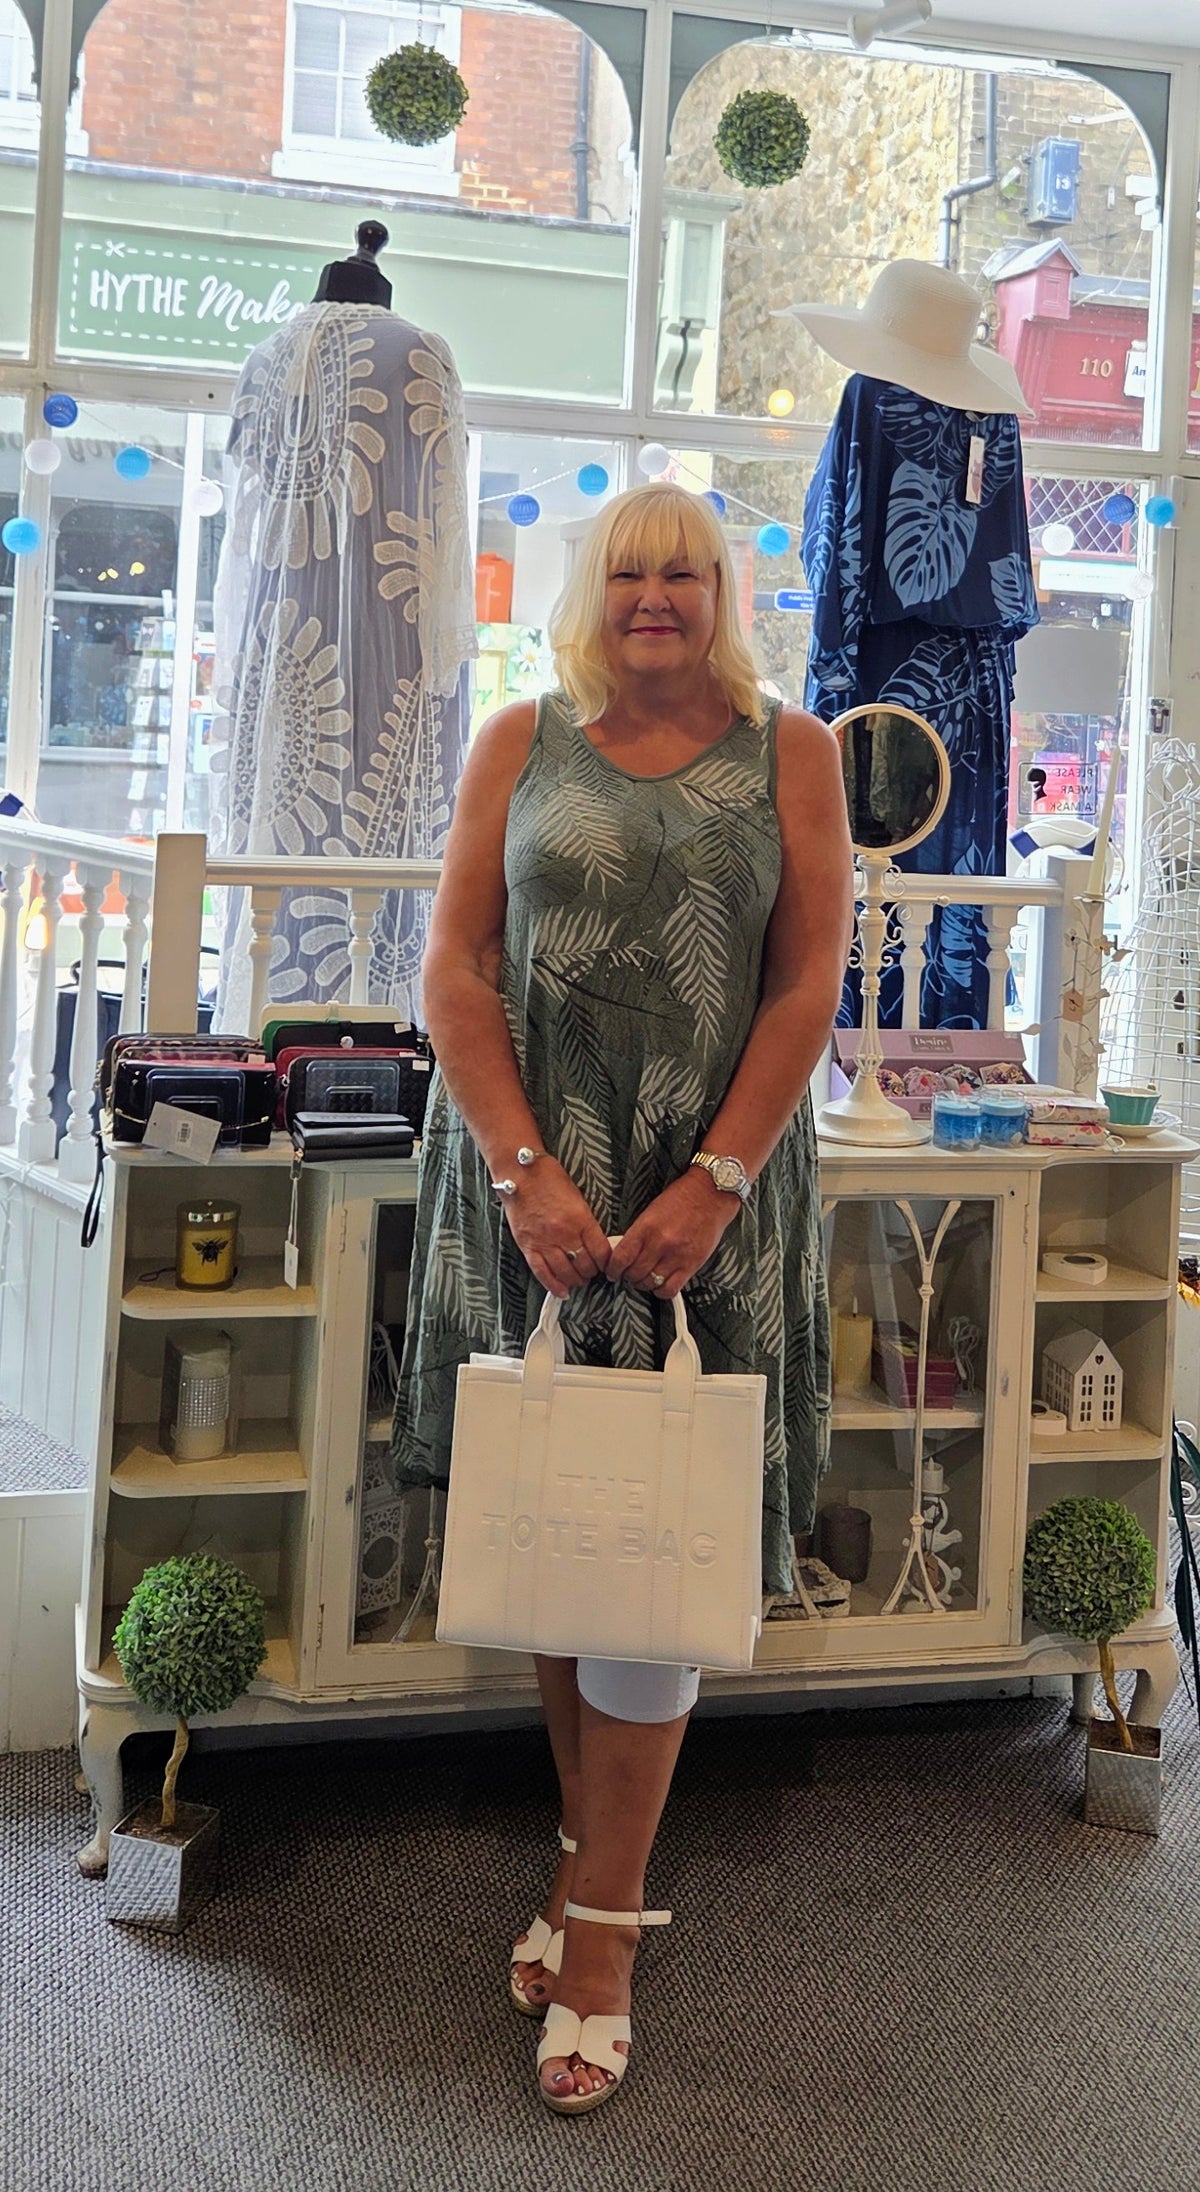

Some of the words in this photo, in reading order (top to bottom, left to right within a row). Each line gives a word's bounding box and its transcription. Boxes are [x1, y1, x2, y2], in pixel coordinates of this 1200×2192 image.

[89, 268, 189, 317] HYTHE
[1080, 358, 1112, 378] 110
[556, 1473, 647, 1517] THE
[481, 1512, 599, 1561] TOTE
[617, 1526, 718, 1568] BAG
